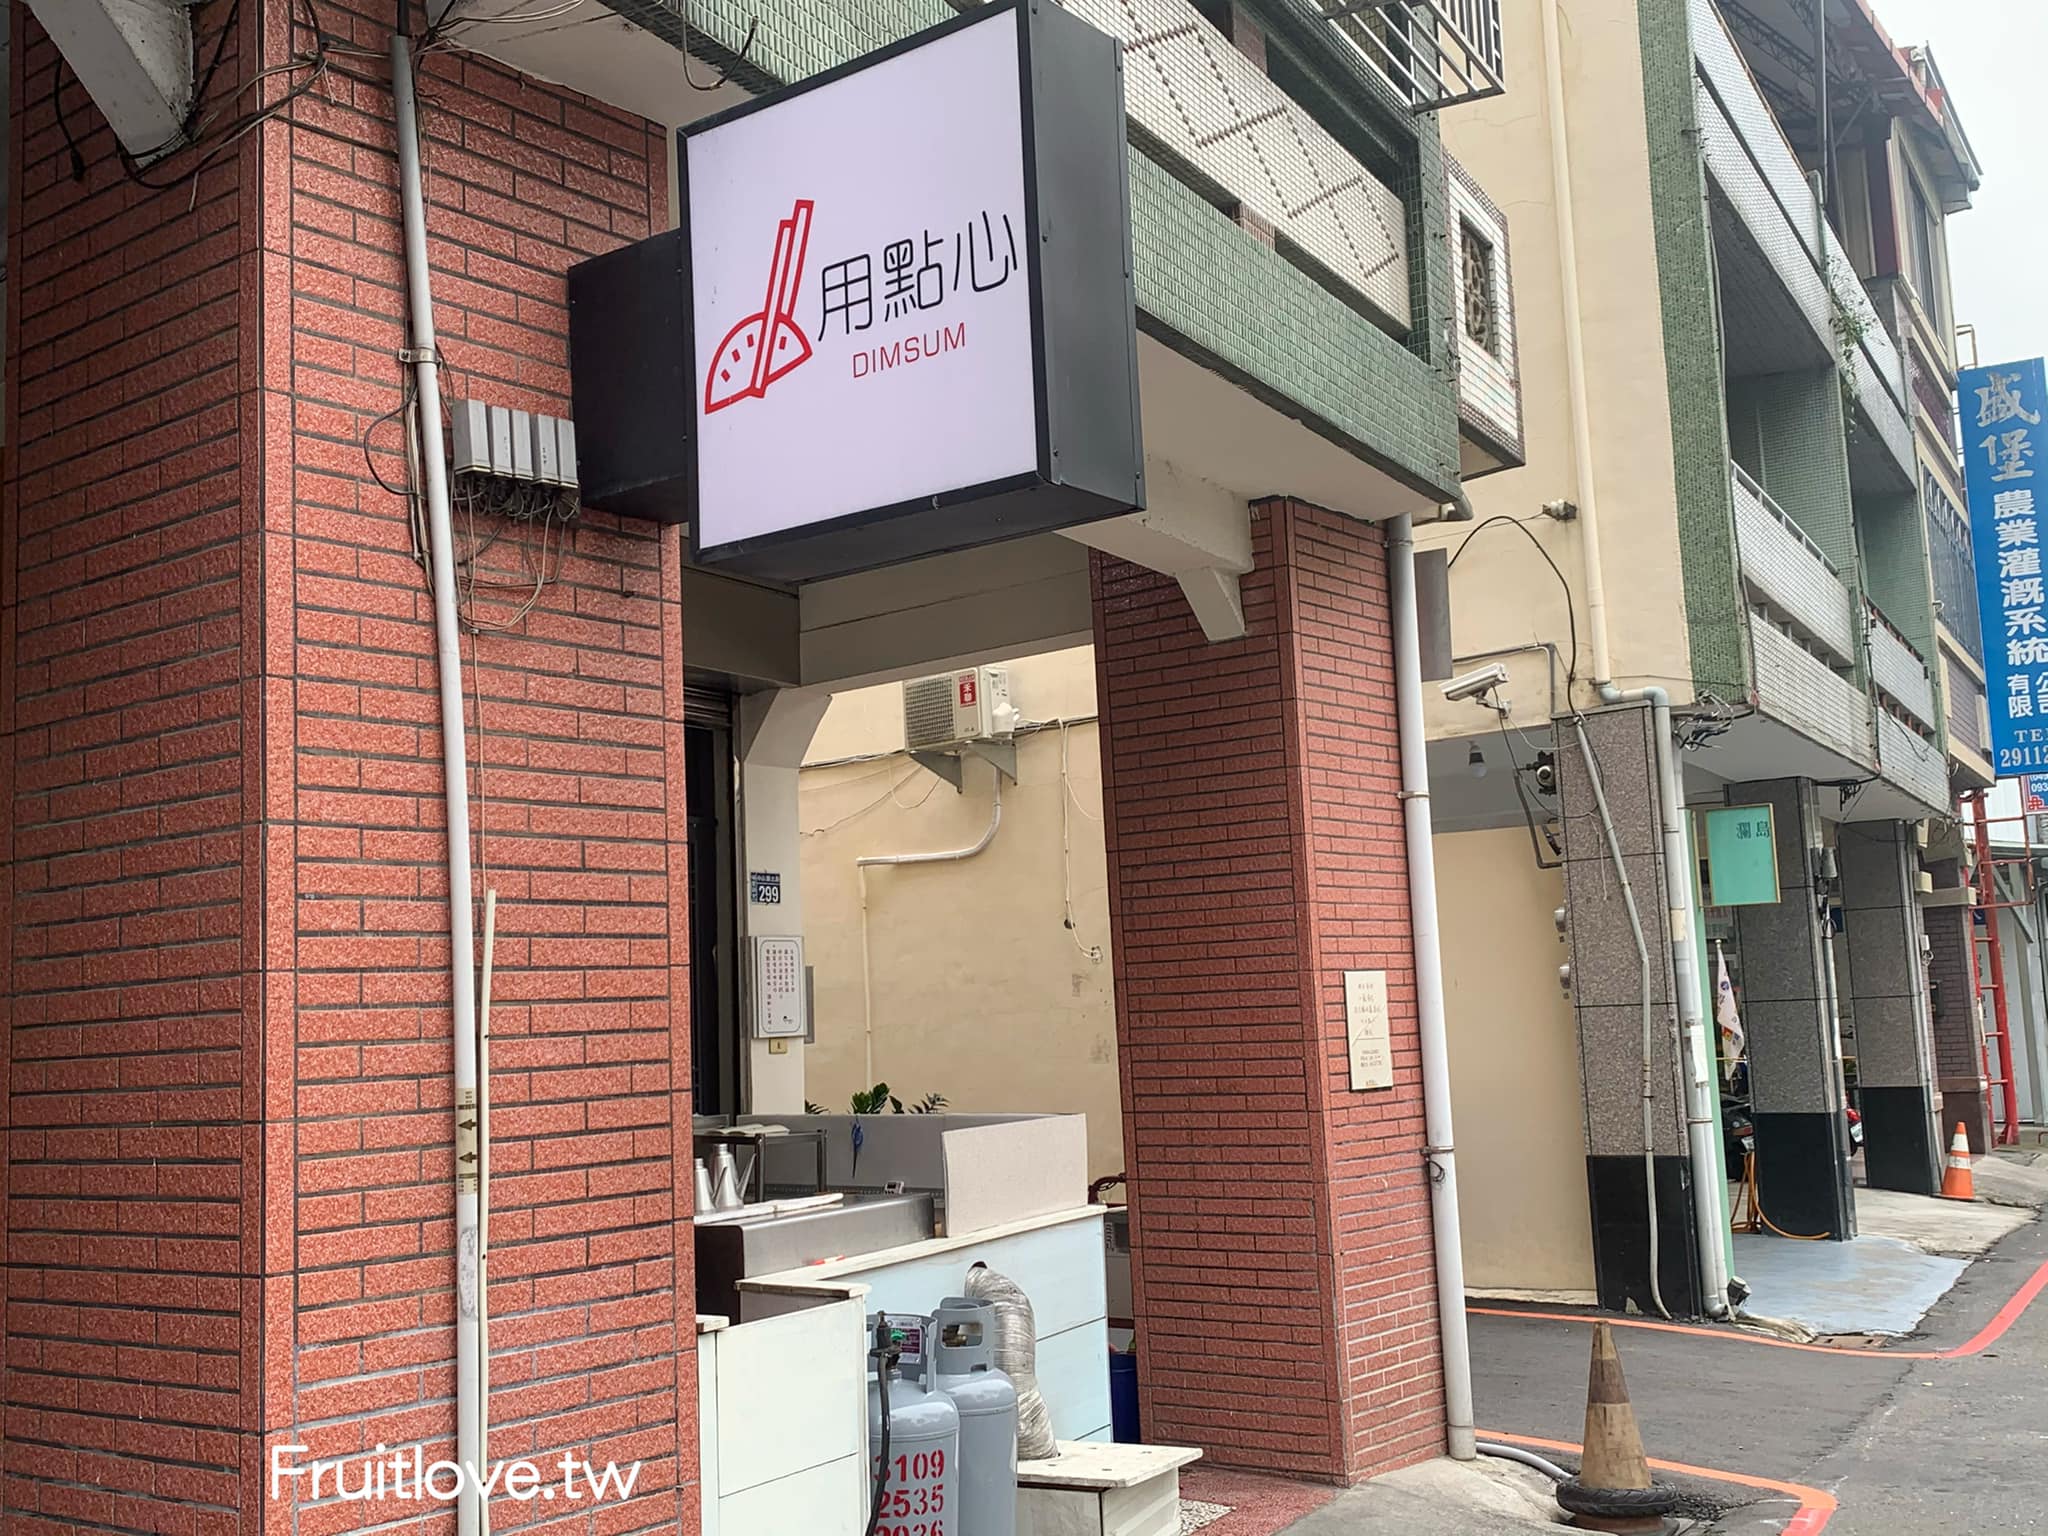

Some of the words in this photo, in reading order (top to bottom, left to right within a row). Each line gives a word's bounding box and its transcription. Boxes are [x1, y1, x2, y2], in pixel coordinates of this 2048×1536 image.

[818, 210, 1017, 341] 用點心
[852, 322, 966, 379] DIMSUM
[2014, 729, 2048, 743] TE
[759, 885, 779, 903] 299
